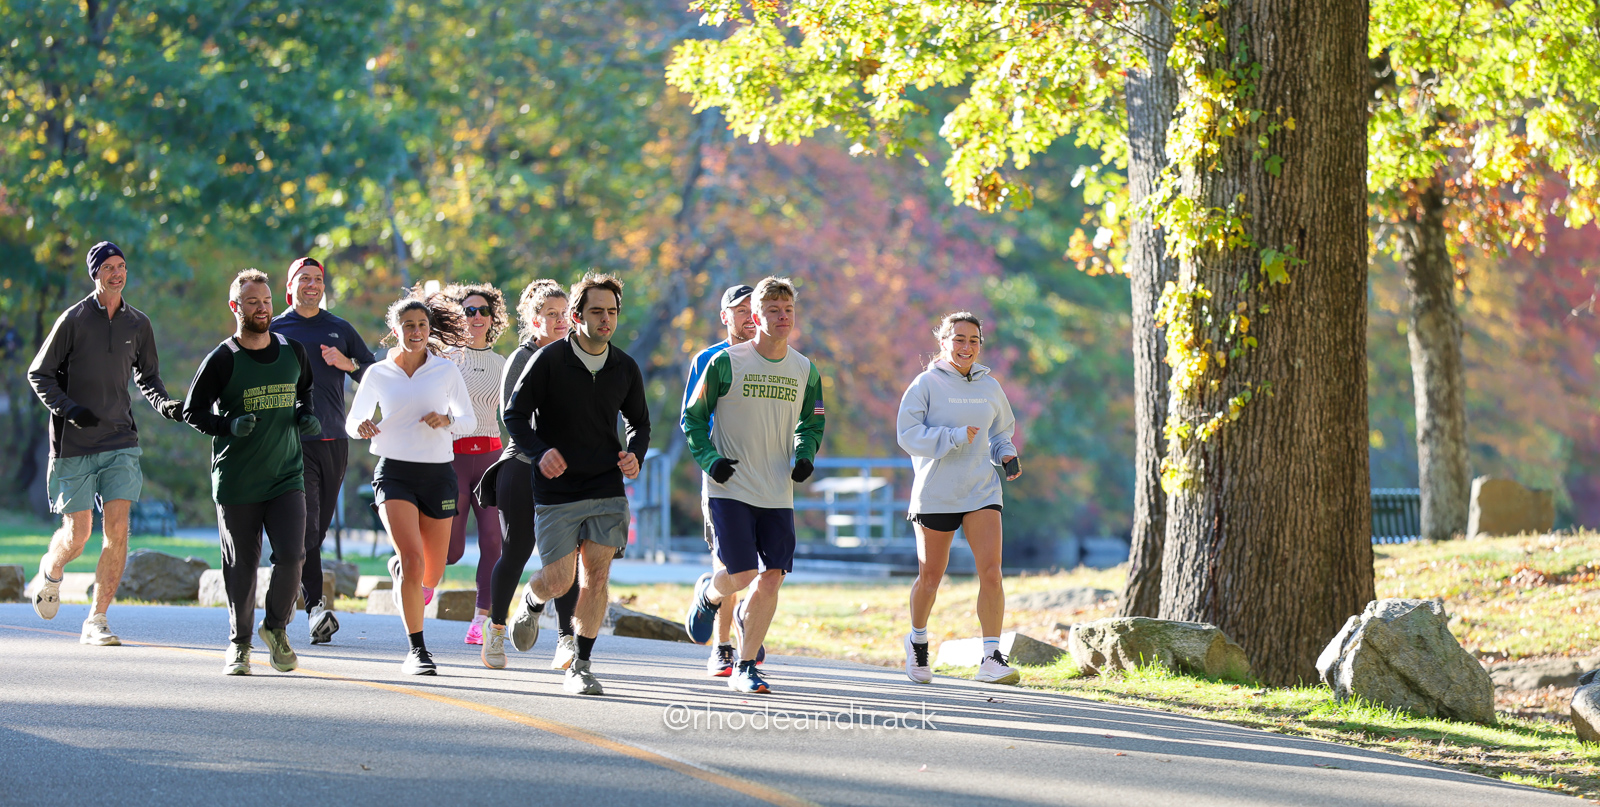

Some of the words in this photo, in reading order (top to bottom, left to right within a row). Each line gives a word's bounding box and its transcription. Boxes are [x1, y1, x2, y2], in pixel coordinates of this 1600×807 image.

[743, 374, 767, 382] ADULT
[768, 375, 799, 387] SENTINEL
[243, 385, 267, 398] ADULT
[267, 383, 296, 394] SENTINE
[742, 383, 798, 402] STRIDERS
